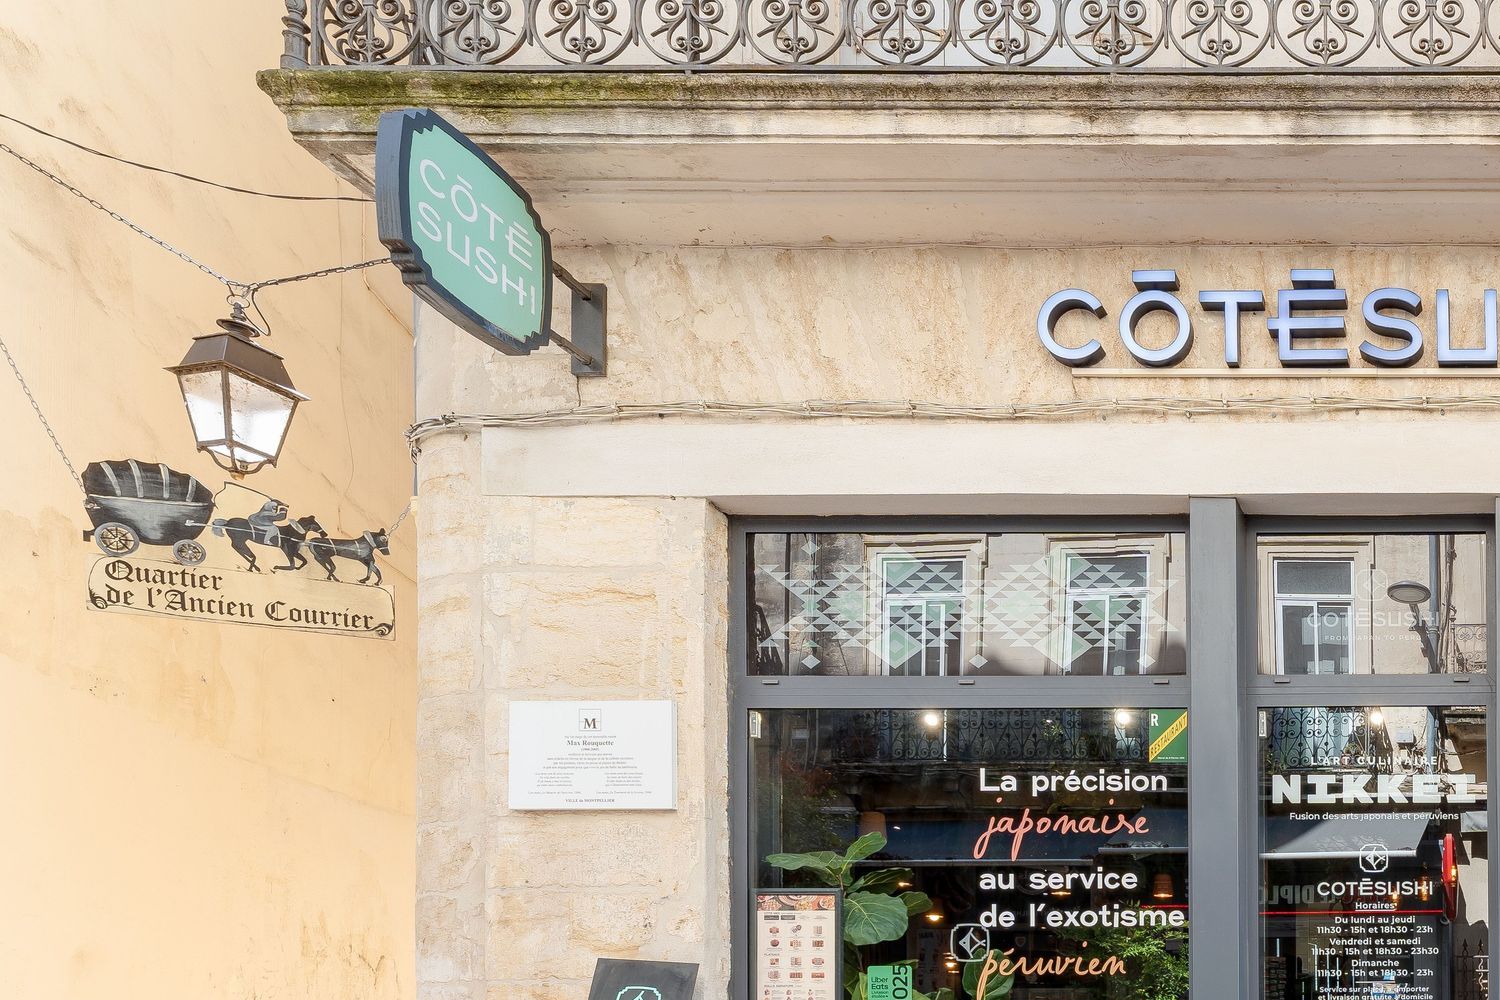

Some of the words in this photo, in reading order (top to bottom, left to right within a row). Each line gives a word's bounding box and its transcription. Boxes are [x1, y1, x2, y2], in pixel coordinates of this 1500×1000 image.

[417, 201, 536, 315] SUSHI
[105, 559, 223, 591] Quartier
[106, 584, 135, 606] de
[147, 587, 255, 618] l'Ancien
[265, 601, 377, 629] Courrier
[584, 718, 597, 729] M
[1151, 713, 1159, 726] R
[1150, 715, 1186, 757] RESTAURANT
[1358, 756, 1437, 766] CULINAIRE
[979, 768, 1017, 792] La
[1032, 768, 1168, 797] précision
[1272, 775, 1476, 804] NIKKEI
[1289, 812, 1321, 820] Fusion
[1322, 812, 1339, 820] des
[1360, 812, 1399, 822] japonais
[1413, 812, 1459, 822] péruviens
[973, 798, 1150, 861] japonaise
[979, 872, 1015, 890] au
[1029, 866, 1138, 890] service
[1355, 902, 1395, 910] Horaires
[979, 903, 1015, 927] de
[1029, 903, 1185, 927] l'exotisme
[1334, 916, 1350, 924] Du
[1351, 916, 1376, 924] lundi
[1391, 916, 1416, 925] jeudi
[1316, 926, 1342, 934] 11h30
[1351, 926, 1366, 934] 15h
[1369, 926, 1379, 934] et
[1380, 926, 1407, 934] 18h30
[1416, 926, 1433, 934] 23h
[1329, 938, 1372, 946] Vendredi
[1386, 937, 1421, 946] samedi
[1351, 959, 1400, 967] Dimanche
[1317, 969, 1342, 977] 11h30
[1351, 969, 1366, 977] 15h
[1369, 969, 1379, 977] et
[1381, 969, 1408, 977] 18h30
[1416, 969, 1434, 977] 23h
